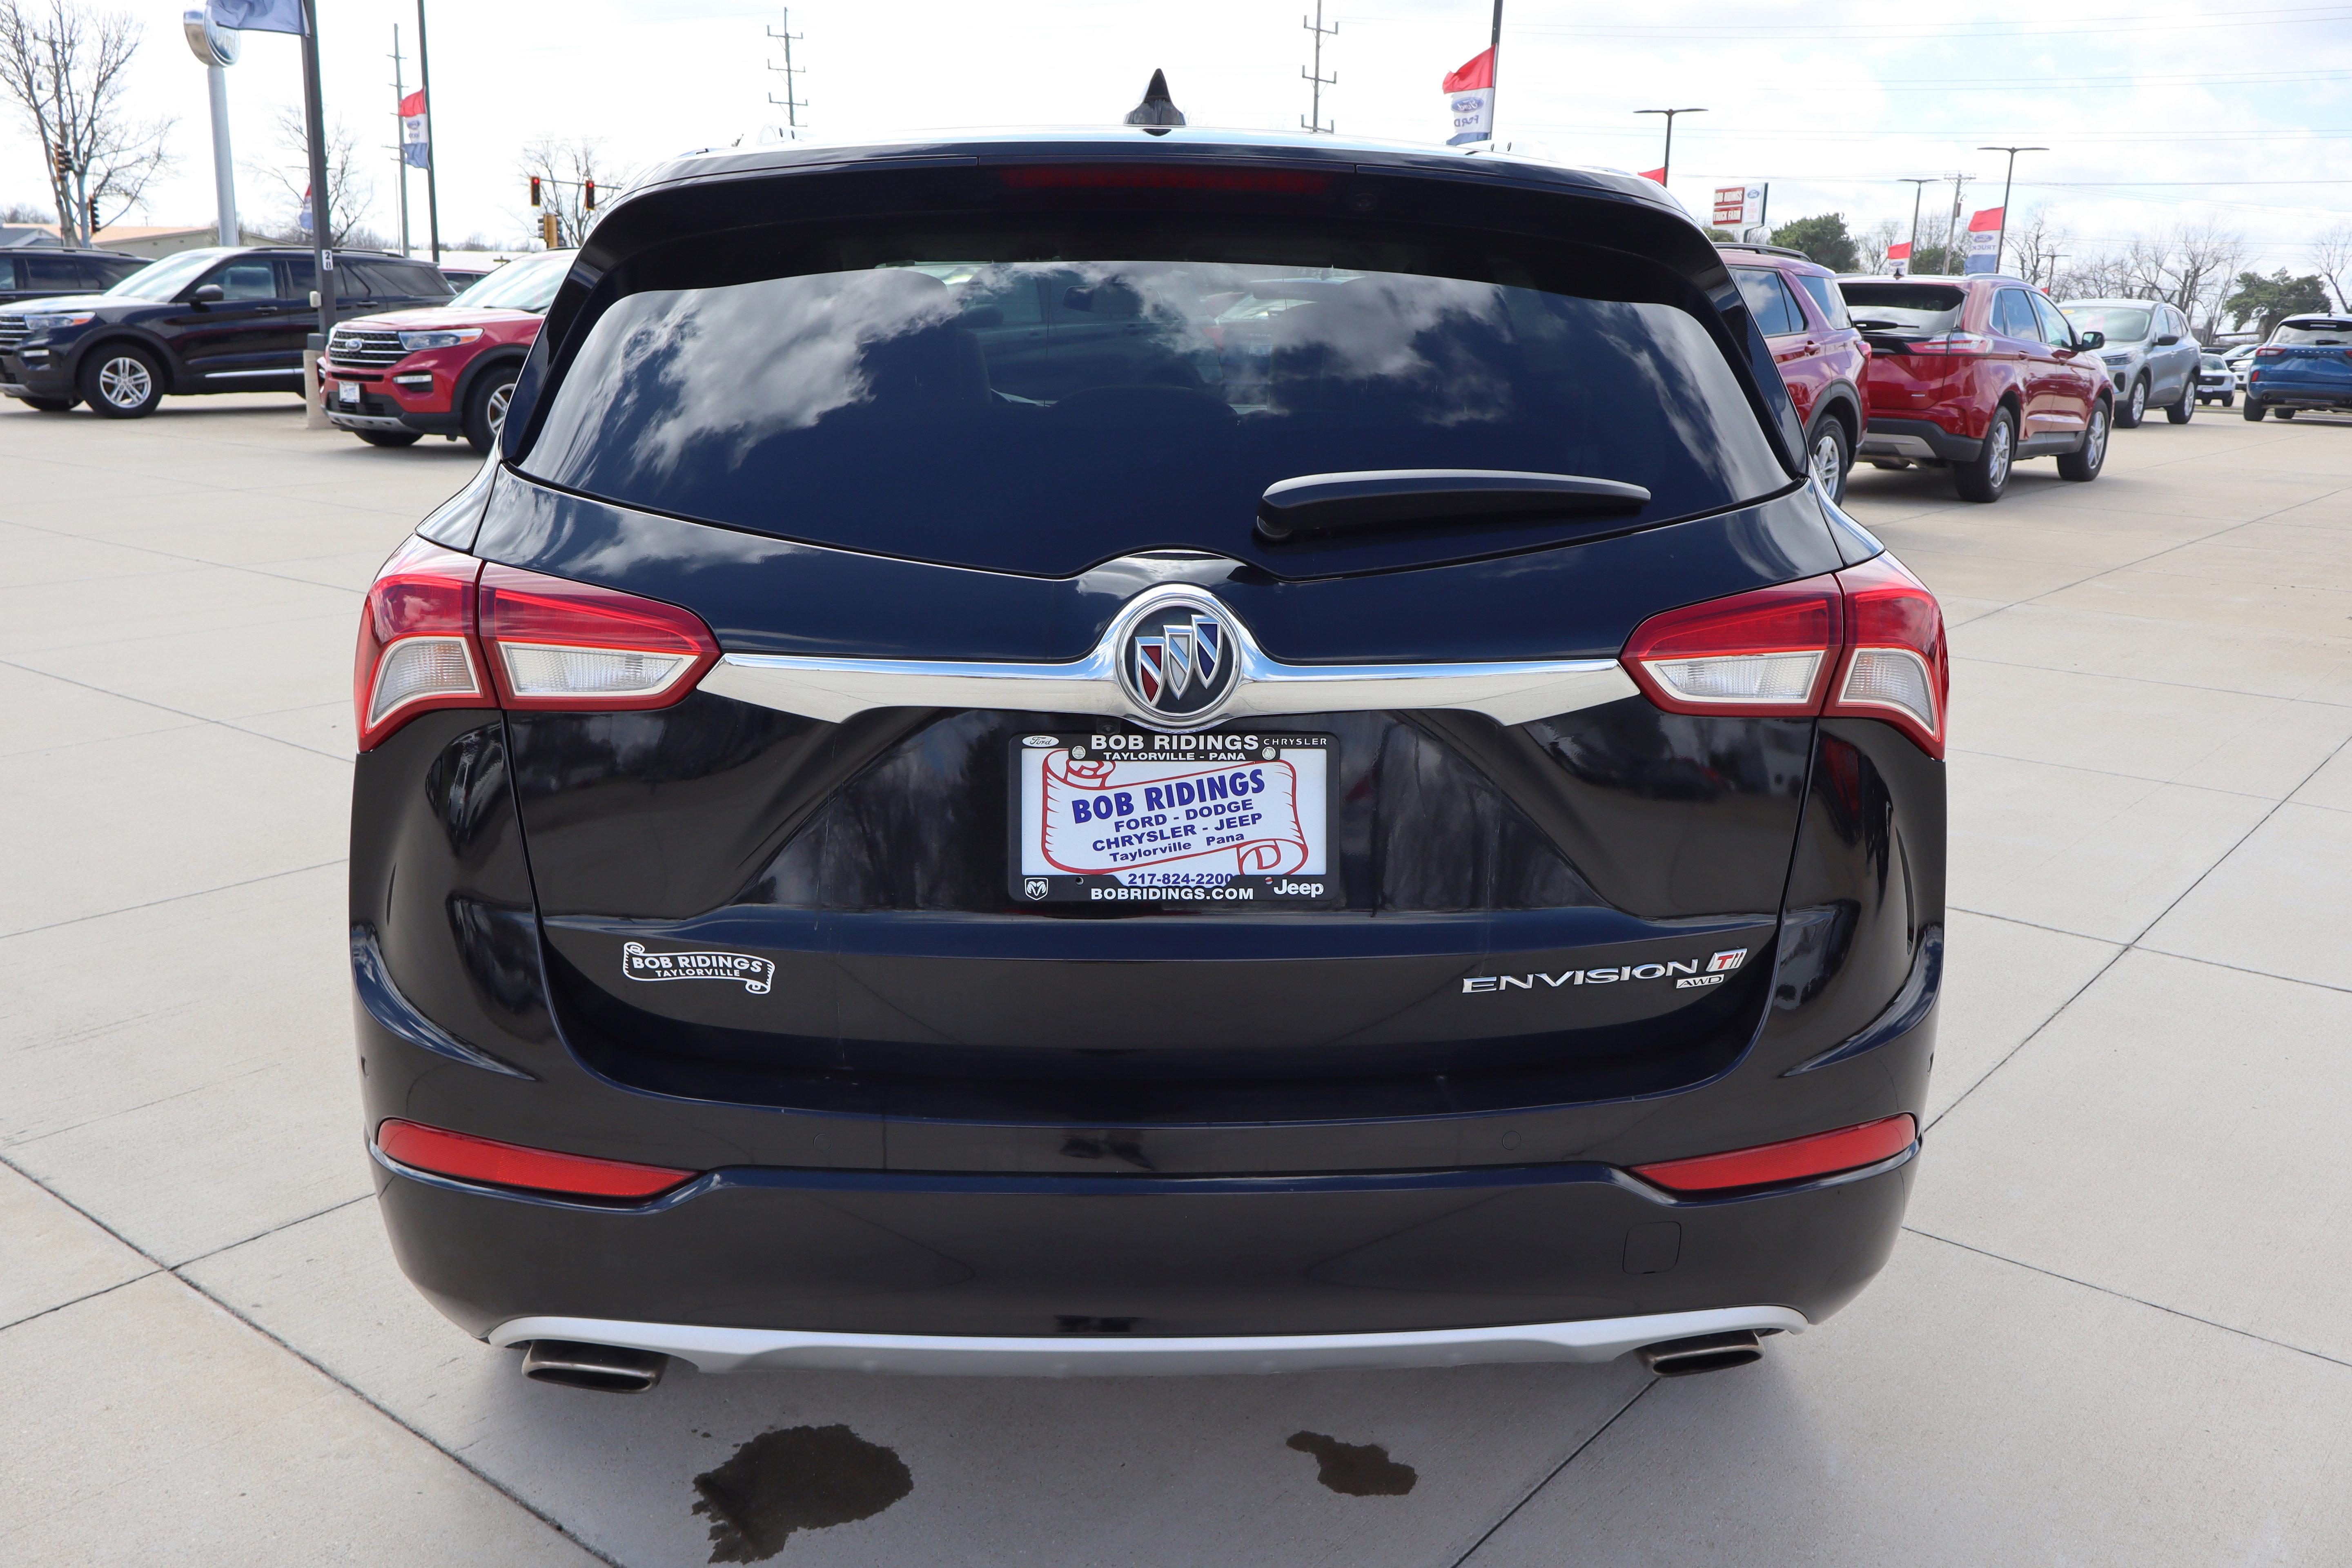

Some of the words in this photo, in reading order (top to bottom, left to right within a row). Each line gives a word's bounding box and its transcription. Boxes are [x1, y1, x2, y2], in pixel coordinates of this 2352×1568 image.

[1029, 736, 1052, 745] Ford
[1091, 735, 1145, 750] BOB
[1154, 735, 1259, 751] RIDINGS
[1103, 752, 1195, 761] TAYLORVILLE
[1209, 752, 1247, 761] PANA
[1071, 792, 1134, 824] BOB
[1144, 768, 1265, 812] RIDINGS
[1114, 814, 1167, 833] FORD
[1185, 798, 1254, 821] DODGE
[1092, 824, 1198, 851] CHRYSLER
[1214, 813, 1262, 831] JEEP
[1109, 842, 1192, 862] Taylorville
[1206, 833, 1245, 846] Pana
[1128, 873, 1233, 885] 217-824-2200
[1091, 888, 1254, 900] BOBRIDINGS.COM
[1274, 879, 1324, 898] Jeep
[632, 956, 673, 969] BOB
[677, 955, 763, 973] RIDINGS
[655, 968, 740, 978] TAYLORVILLE
[1462, 959, 1698, 993] ENVISION
[1678, 976, 1722, 988] AWD
